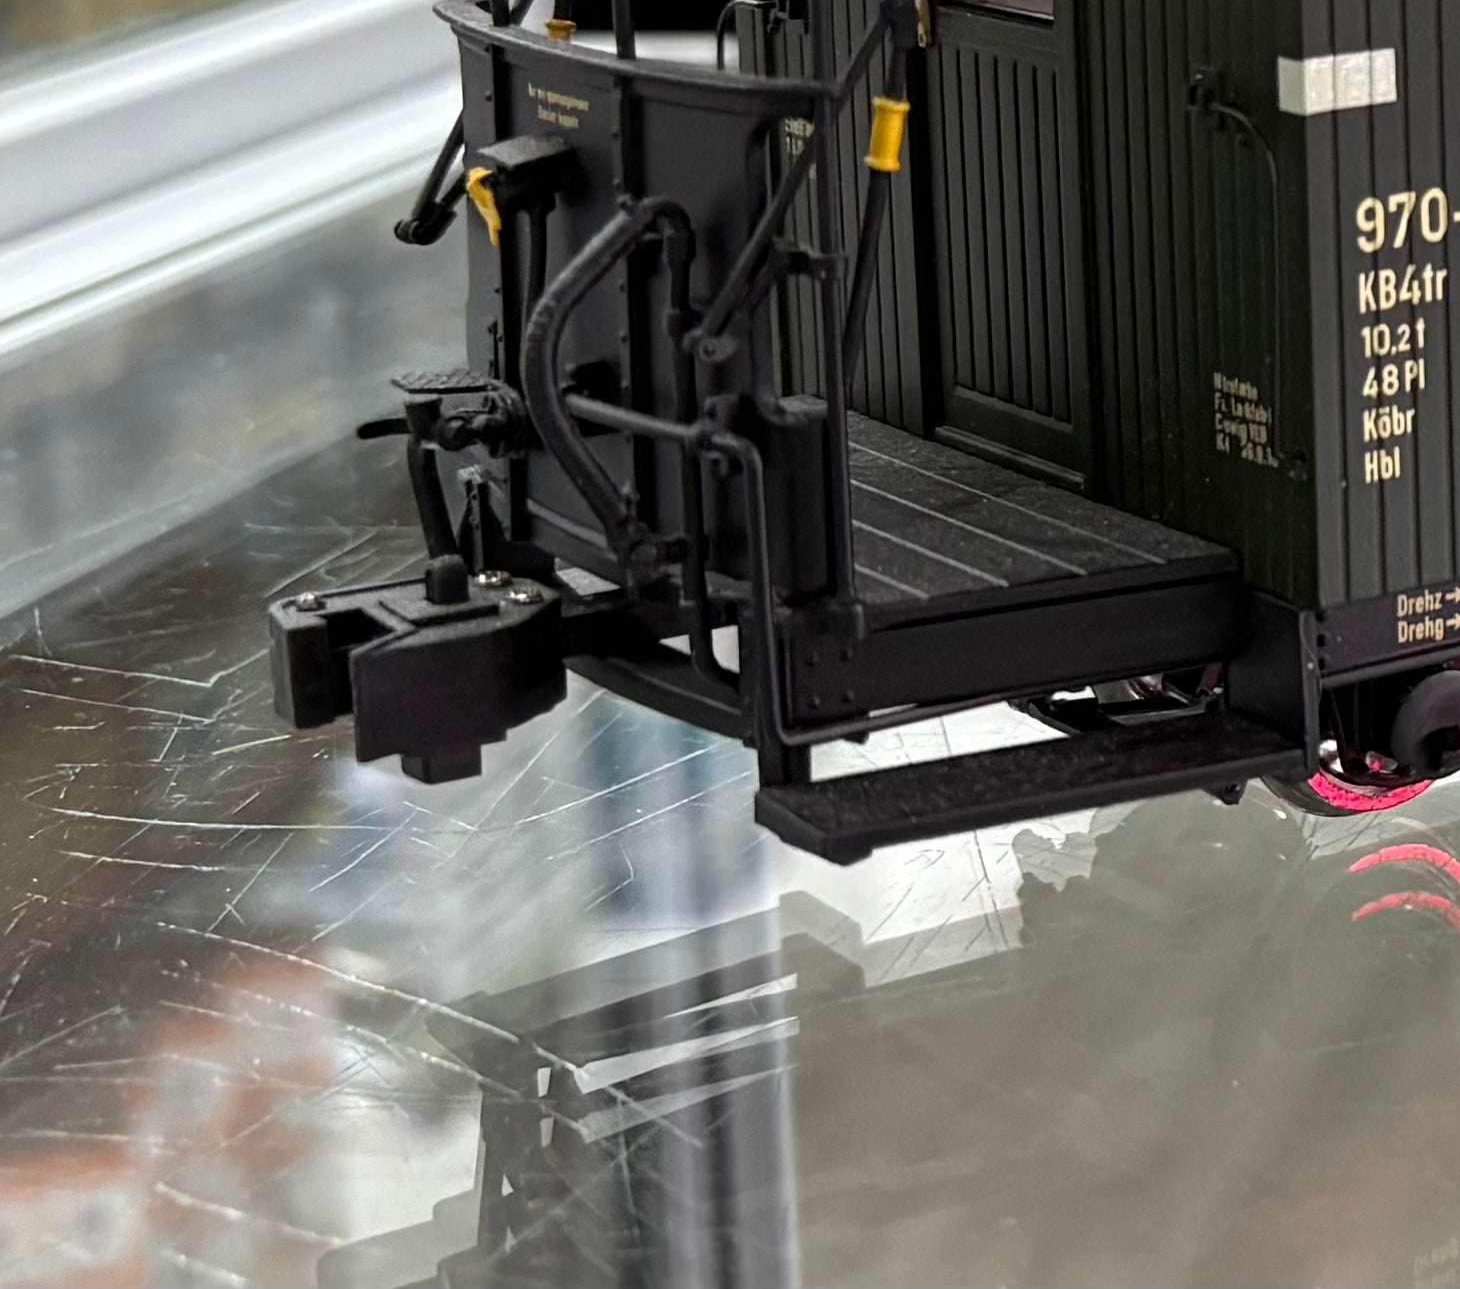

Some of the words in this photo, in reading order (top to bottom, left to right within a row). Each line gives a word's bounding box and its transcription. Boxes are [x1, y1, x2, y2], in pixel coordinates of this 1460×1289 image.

[1358, 262, 1448, 314] KB4tr
[1362, 364, 1400, 399] 48
[1362, 404, 1416, 443] Köbr
[1396, 588, 1443, 618] Drehz
[1397, 614, 1445, 644] Drehg
